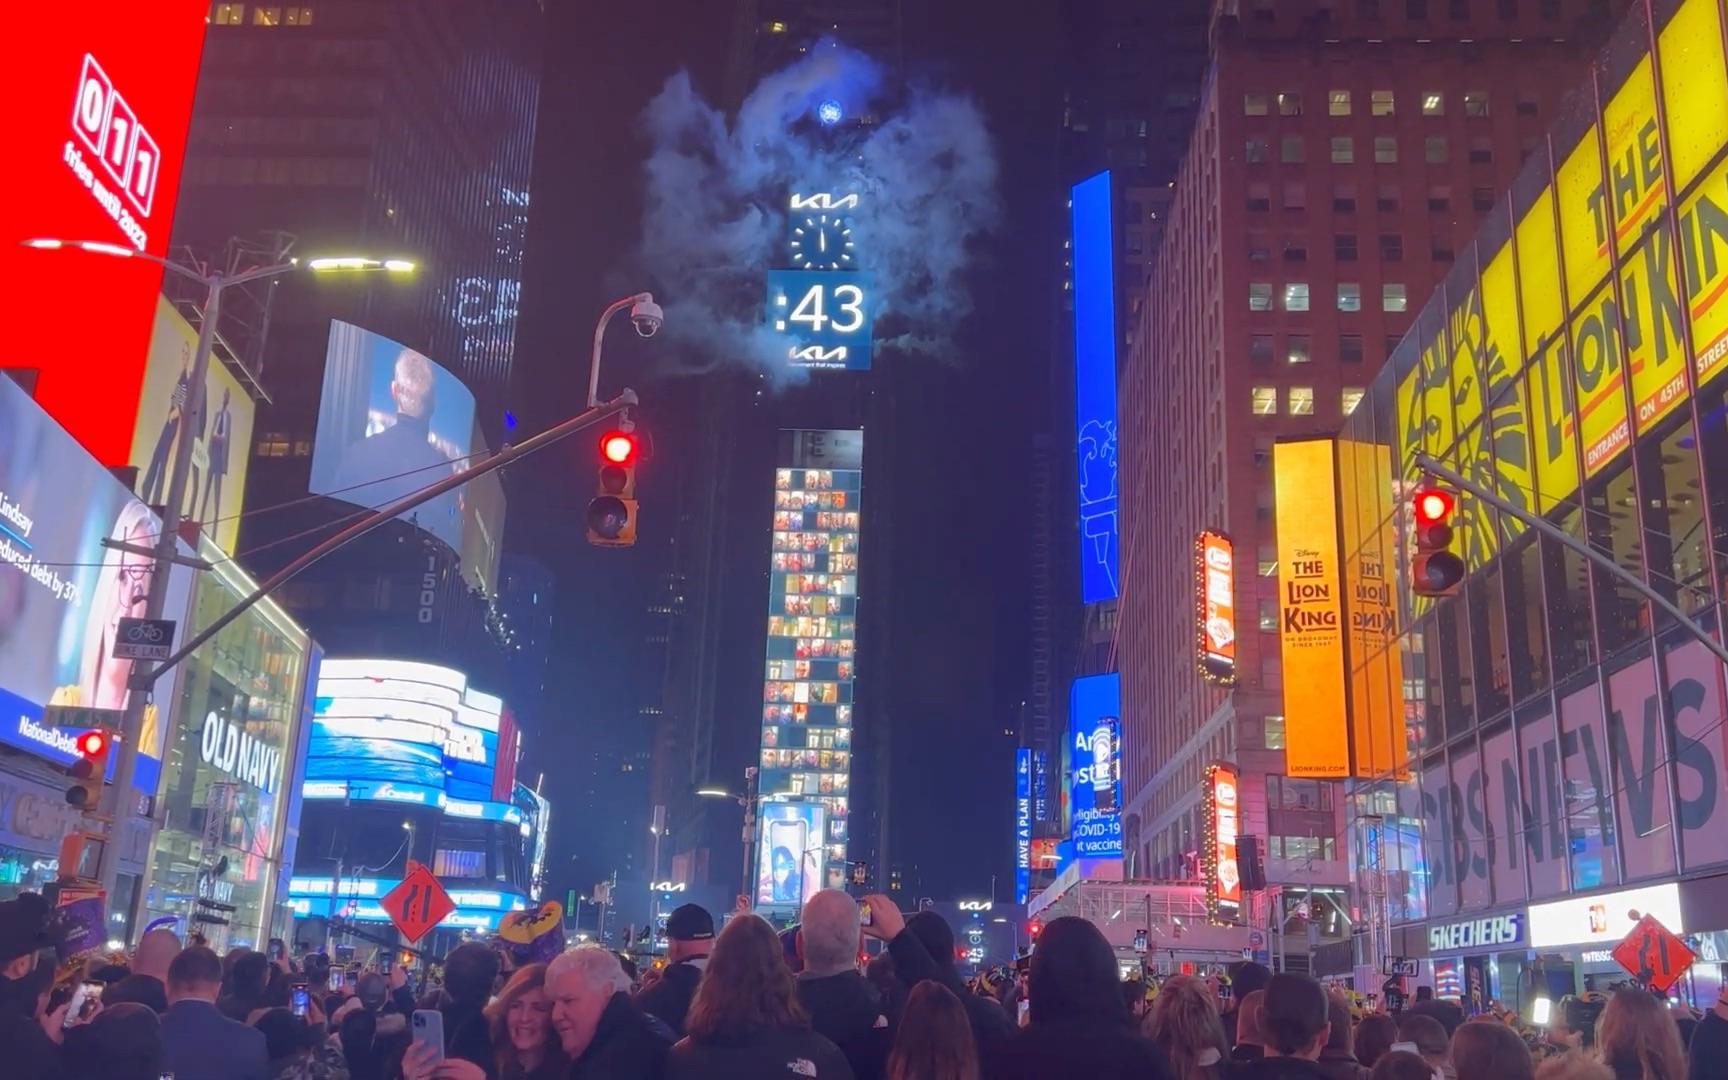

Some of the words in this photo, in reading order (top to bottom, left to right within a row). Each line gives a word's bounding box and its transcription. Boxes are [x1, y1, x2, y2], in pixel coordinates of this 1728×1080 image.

[64, 141, 94, 188] fries
[92, 179, 122, 221] until
[1587, 116, 1662, 245] THE
[775, 284, 864, 332] :43
[1588, 422, 1629, 465] ENTRANCE
[1639, 402, 1655, 421] ON
[1660, 374, 1684, 404] 45TH
[1292, 561, 1323, 574] THE
[1294, 549, 1319, 558] Disney
[31, 559, 52, 588] debt
[52, 572, 64, 599] by
[202, 711, 239, 773] OLD
[236, 732, 280, 794] NAVY
[1502, 678, 1717, 871] NEWS
[1019, 798, 1029, 827] PLAN
[1019, 829, 1028, 838] A
[1019, 839, 1029, 868] HAVE
[1430, 914, 1518, 951] SKECHERS
